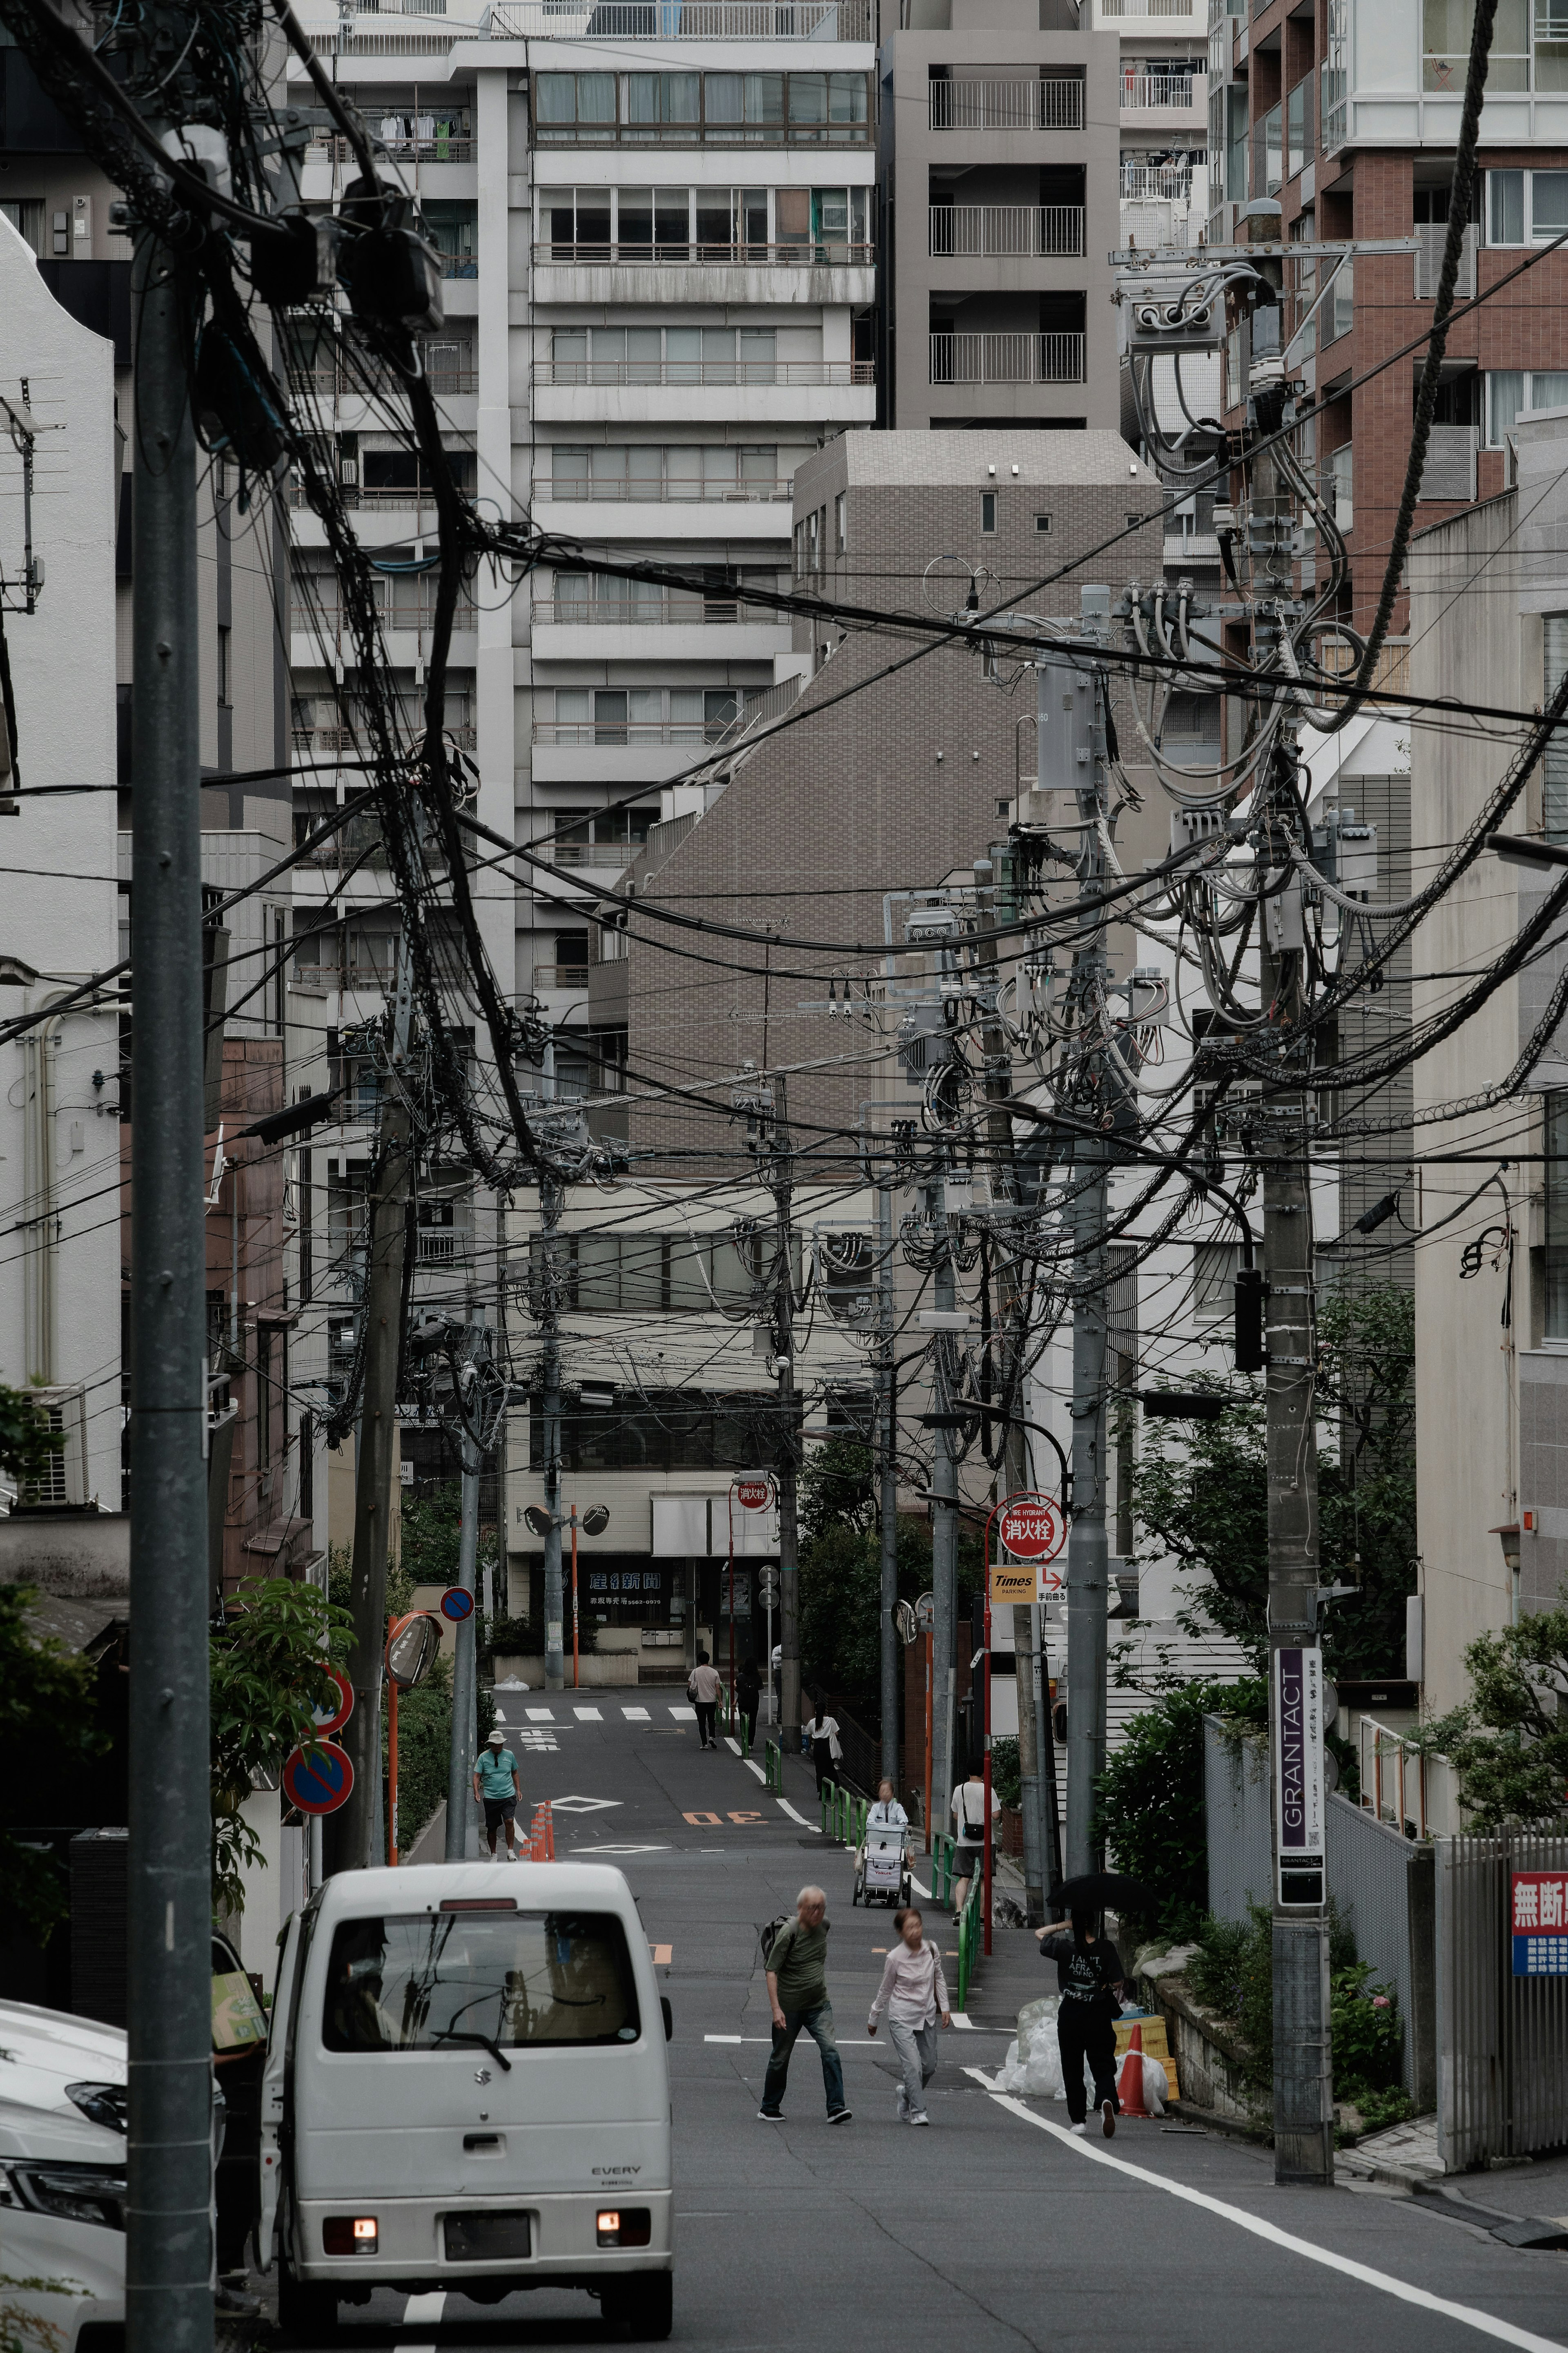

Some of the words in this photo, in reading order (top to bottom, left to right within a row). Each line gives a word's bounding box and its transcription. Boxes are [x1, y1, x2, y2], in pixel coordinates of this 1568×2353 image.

[740, 1487, 766, 1500] 消火栓
[1006, 1519, 1051, 1540] 消火栓
[996, 1575, 1033, 1586] Times
[1038, 1592, 1065, 1601] 手前曲る
[1283, 1668, 1302, 1827] GRANTACT
[1515, 1881, 1568, 1928] 無断
[1528, 1947, 1568, 1955] 無断駐車
[1076, 1955, 1100, 1965] AI'T
[1069, 1963, 1102, 1972] AFRAD
[1063, 1988, 1094, 2002] GHST
[592, 2166, 641, 2175] EVERY
